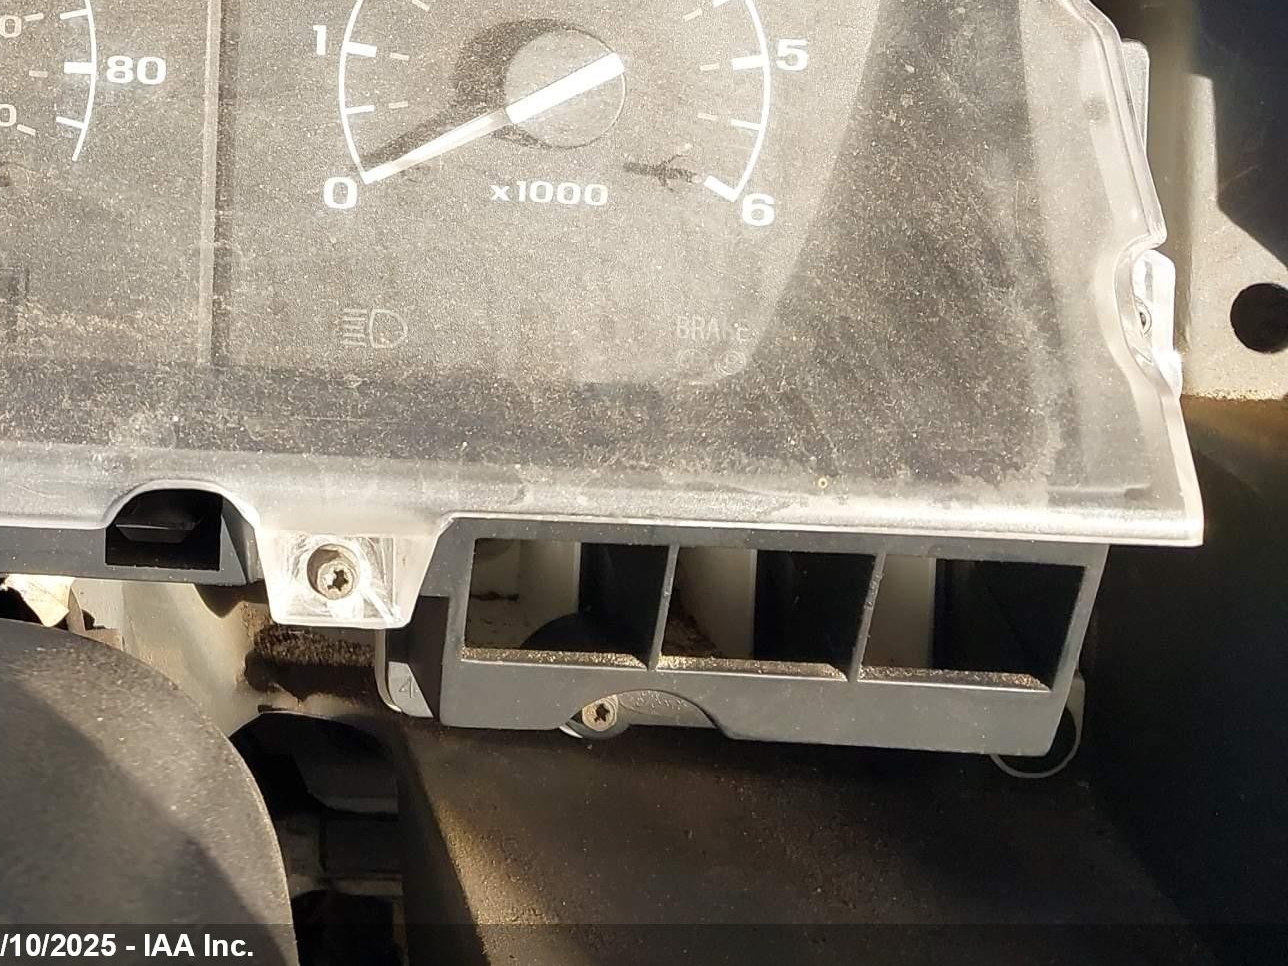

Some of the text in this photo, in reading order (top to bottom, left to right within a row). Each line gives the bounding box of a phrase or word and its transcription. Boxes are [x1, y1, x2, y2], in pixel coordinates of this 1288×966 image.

[312, 25, 328, 55] 1
[776, 39, 809, 71] 5
[106, 56, 166, 85] 80
[324, 177, 358, 210] 0
[490, 182, 608, 206] x1000
[742, 194, 775, 227] 6
